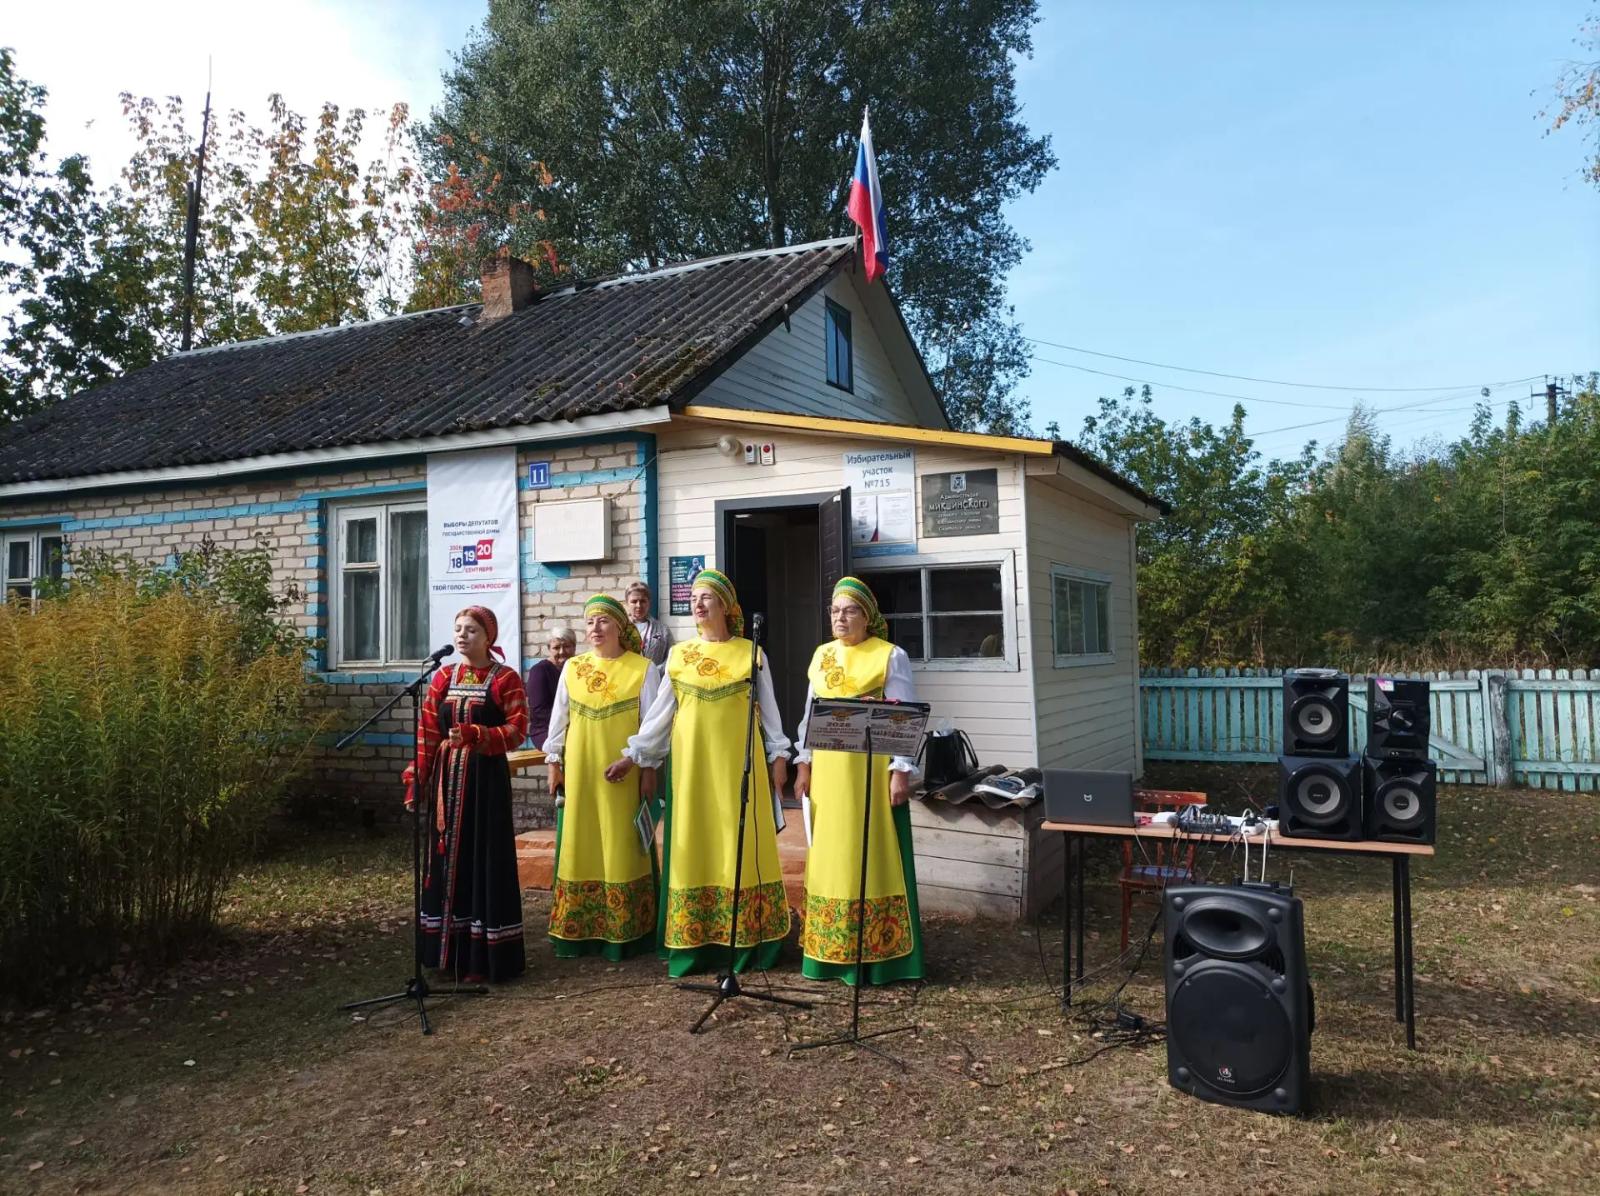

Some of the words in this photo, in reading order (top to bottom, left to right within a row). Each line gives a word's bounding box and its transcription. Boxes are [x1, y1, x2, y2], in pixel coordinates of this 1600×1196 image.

[847, 449, 912, 465] Избирательный
[532, 469, 545, 484] 11
[862, 466, 894, 478] участок
[864, 479, 891, 489] №715
[452, 558, 462, 568] 18
[463, 550, 475, 562] 19
[477, 544, 491, 556] 20
